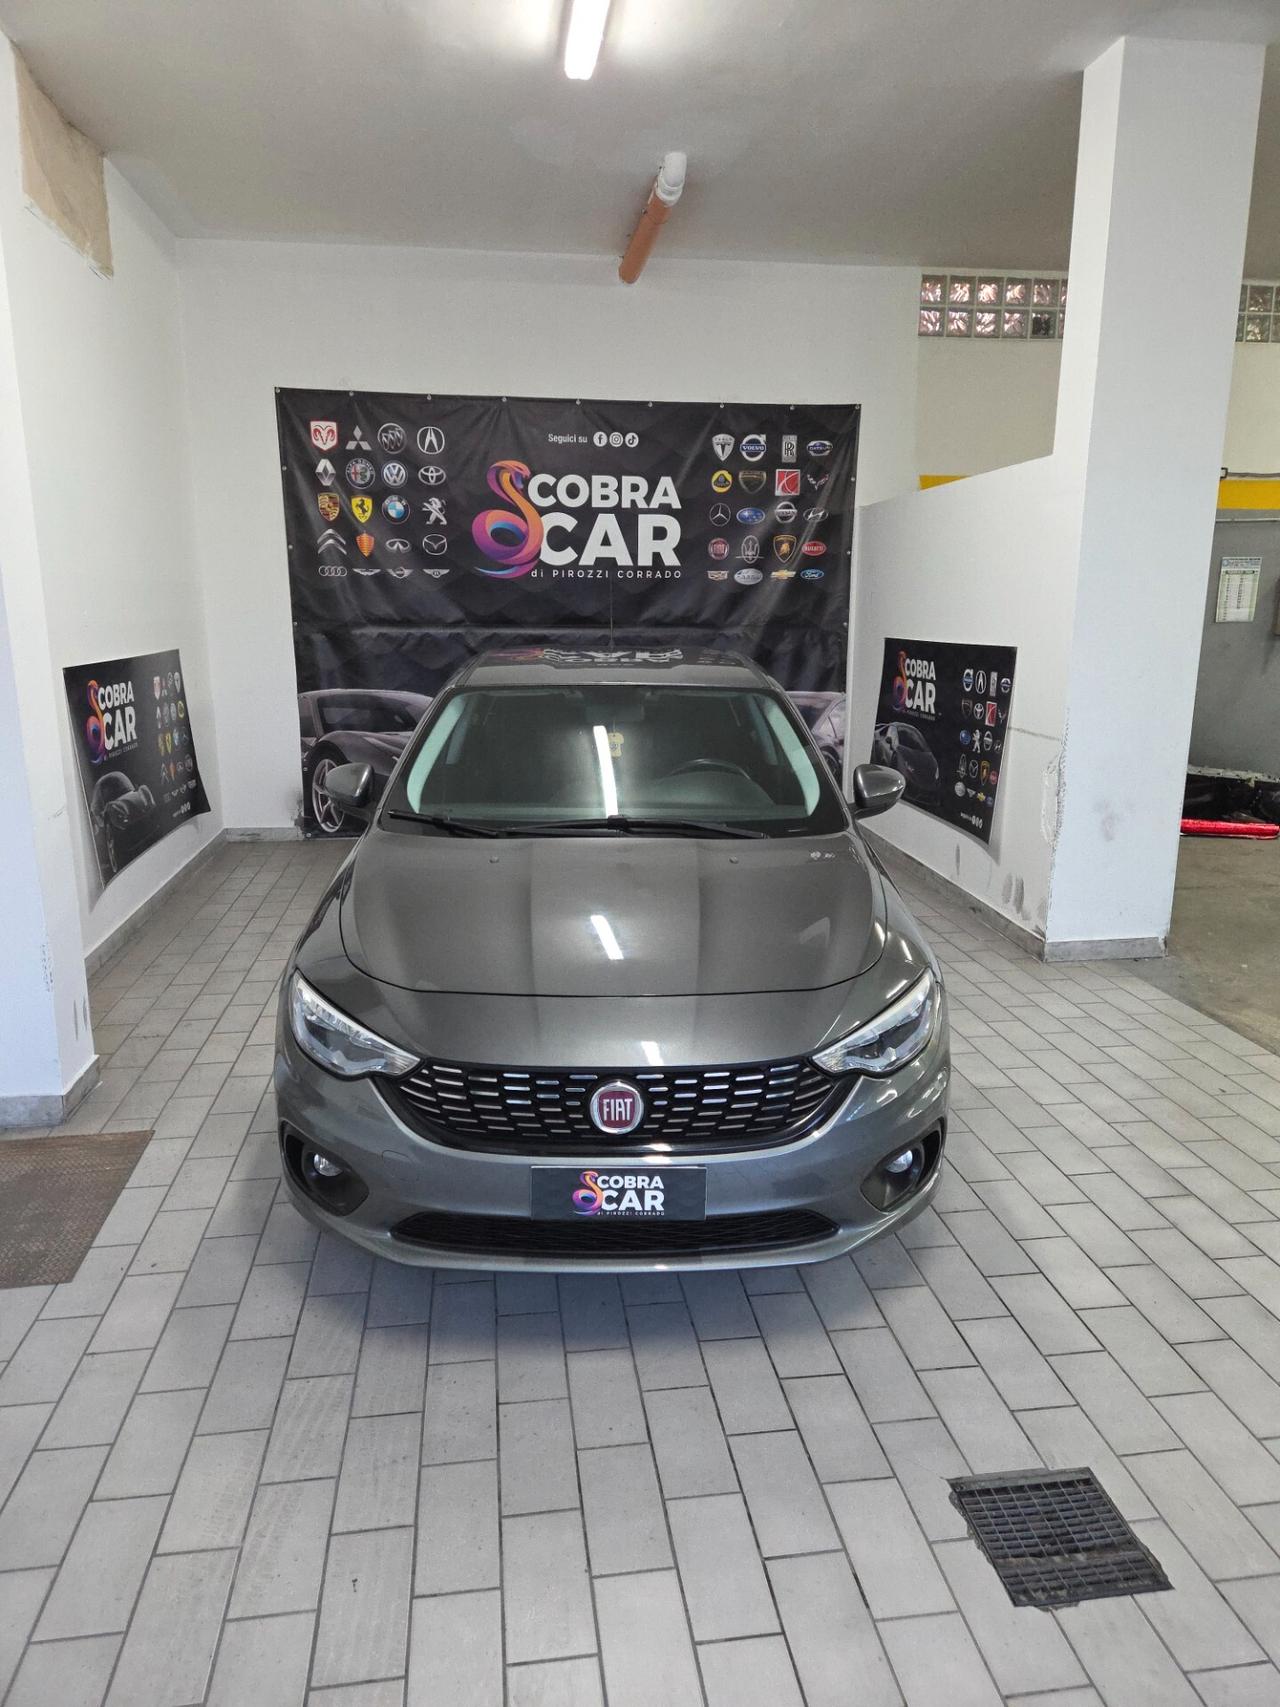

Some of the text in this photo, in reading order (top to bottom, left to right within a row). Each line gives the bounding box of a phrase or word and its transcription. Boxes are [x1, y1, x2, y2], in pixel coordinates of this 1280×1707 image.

[548, 432, 588, 445] Seguici su
[527, 473, 682, 509] COBRA
[539, 511, 682, 567] CAR
[531, 568, 682, 579] di PIROZZI CORRADO
[905, 658, 936, 680] COBRA
[97, 680, 134, 711] COBRA
[905, 680, 936, 714] CAR
[103, 709, 138, 751] CAR
[602, 1098, 633, 1121] FIAT
[597, 1175, 664, 1189] COBRA
[601, 1189, 665, 1211] CAR
